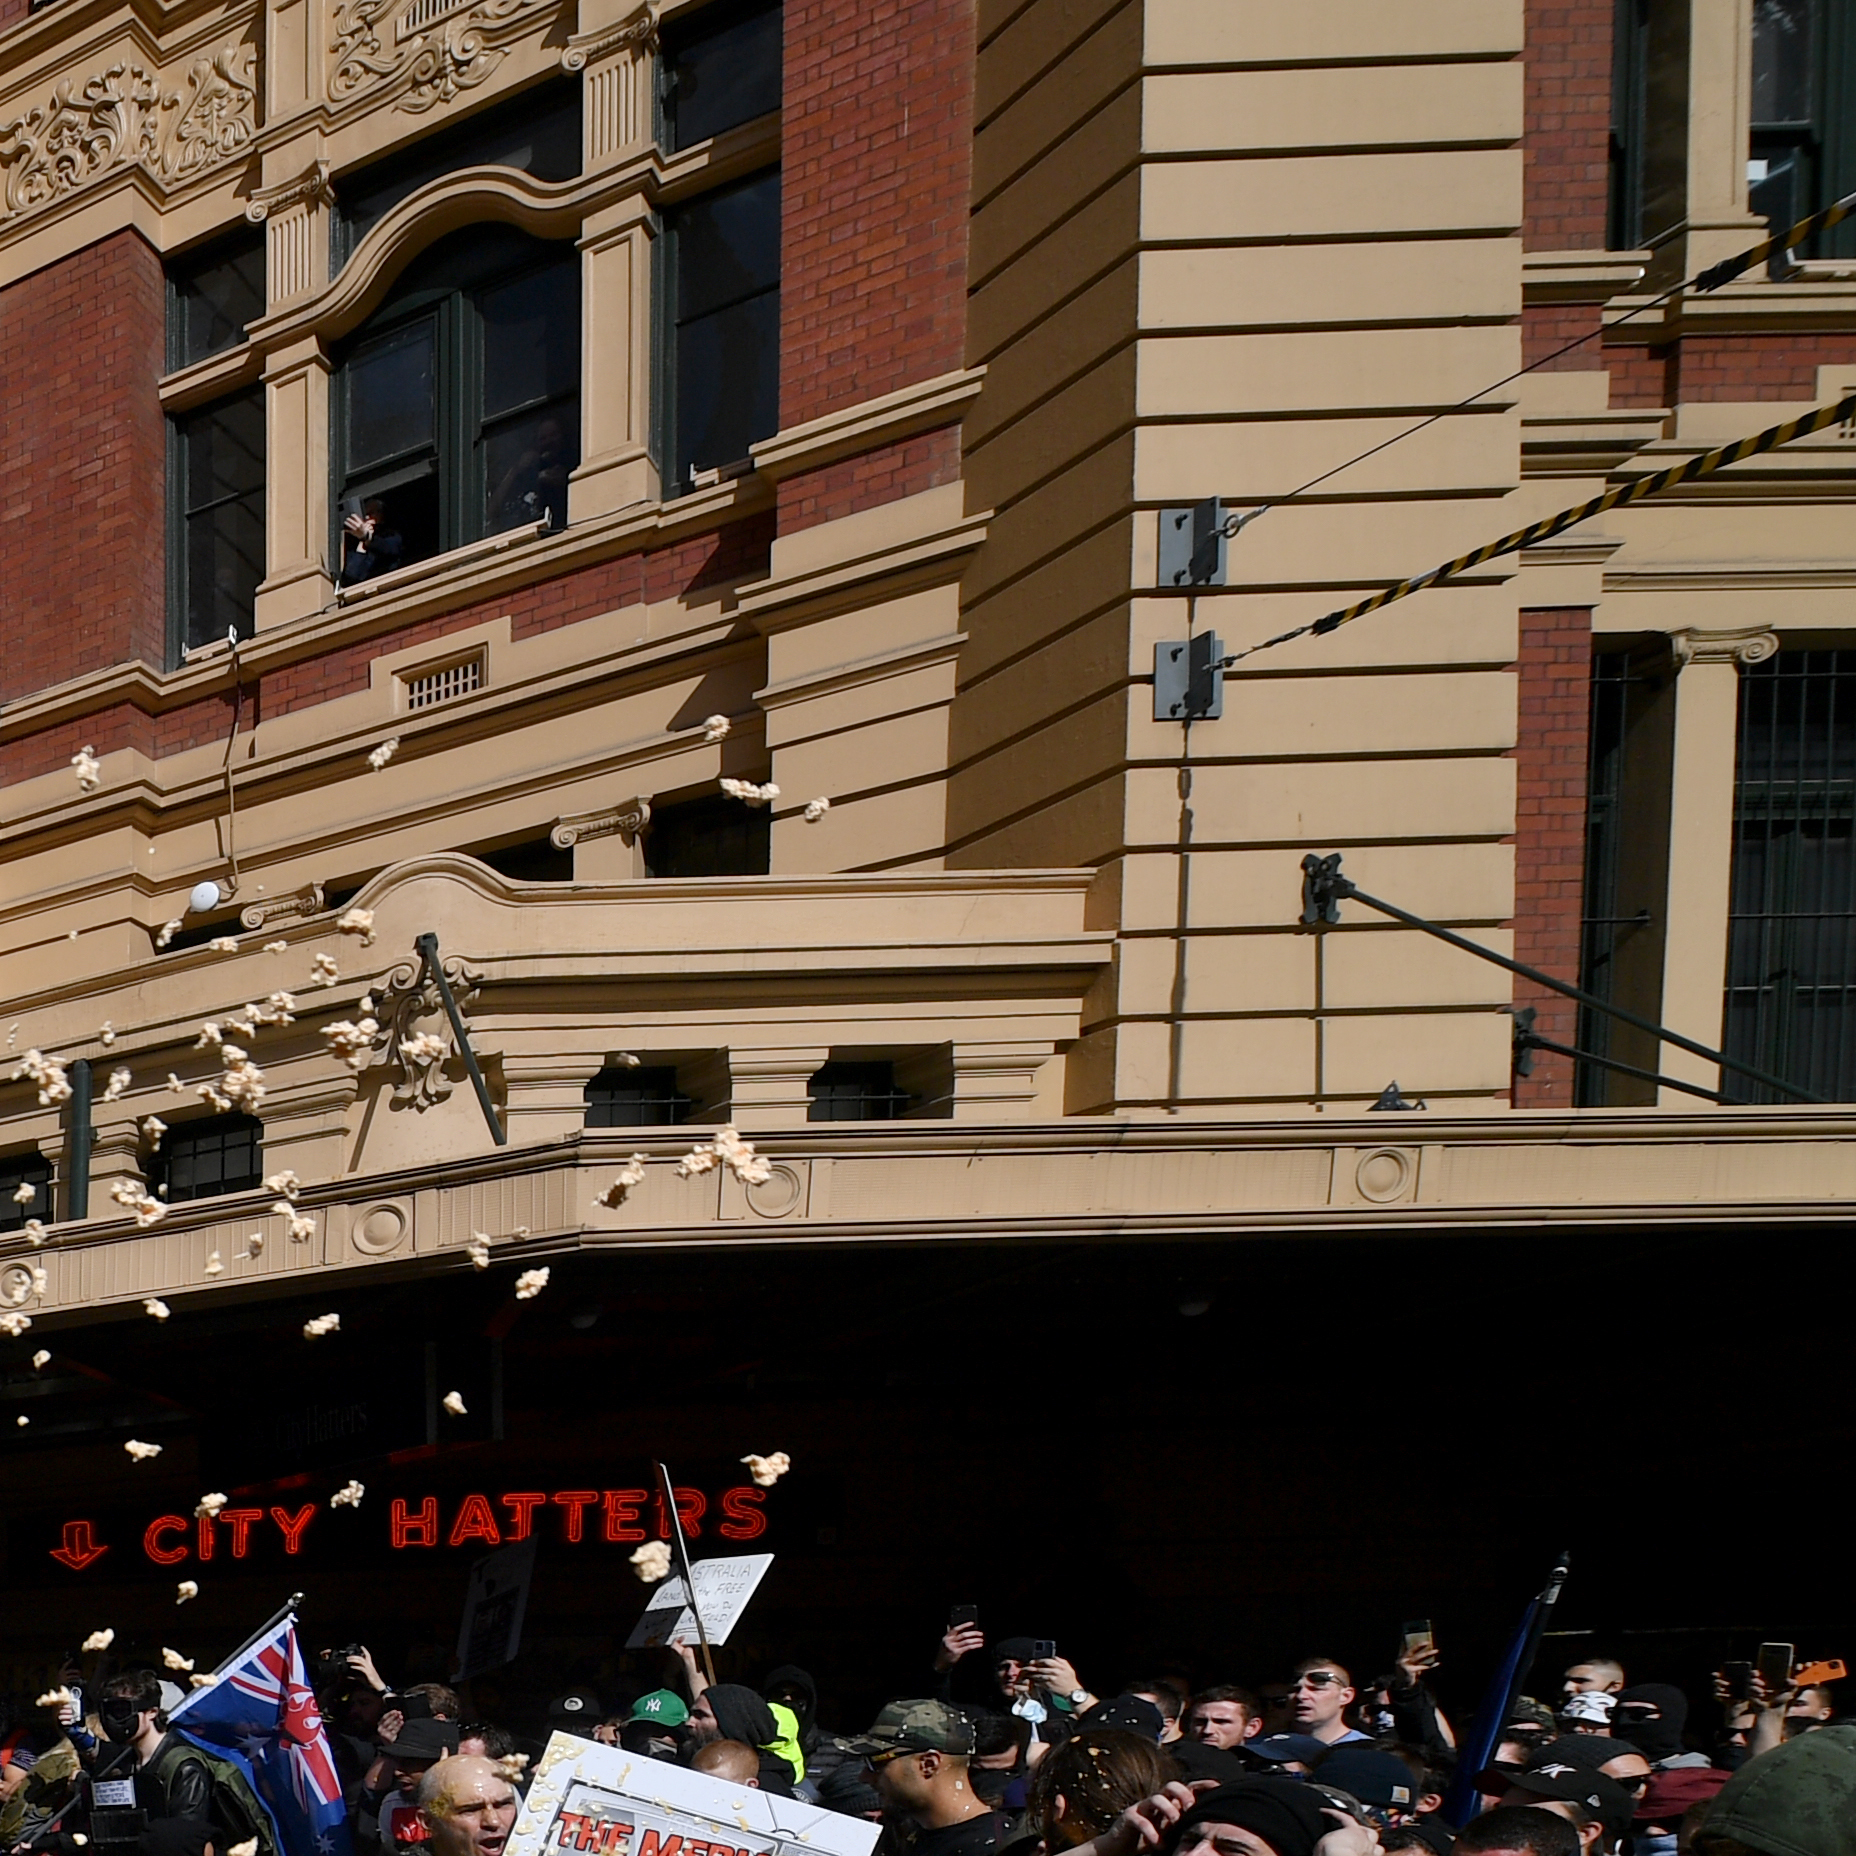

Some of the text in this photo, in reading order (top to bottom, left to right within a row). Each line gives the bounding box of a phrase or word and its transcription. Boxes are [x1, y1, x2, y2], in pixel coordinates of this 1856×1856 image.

[143, 1487, 768, 1564] CITY HATTERS
[557, 1811, 636, 1856] THE
